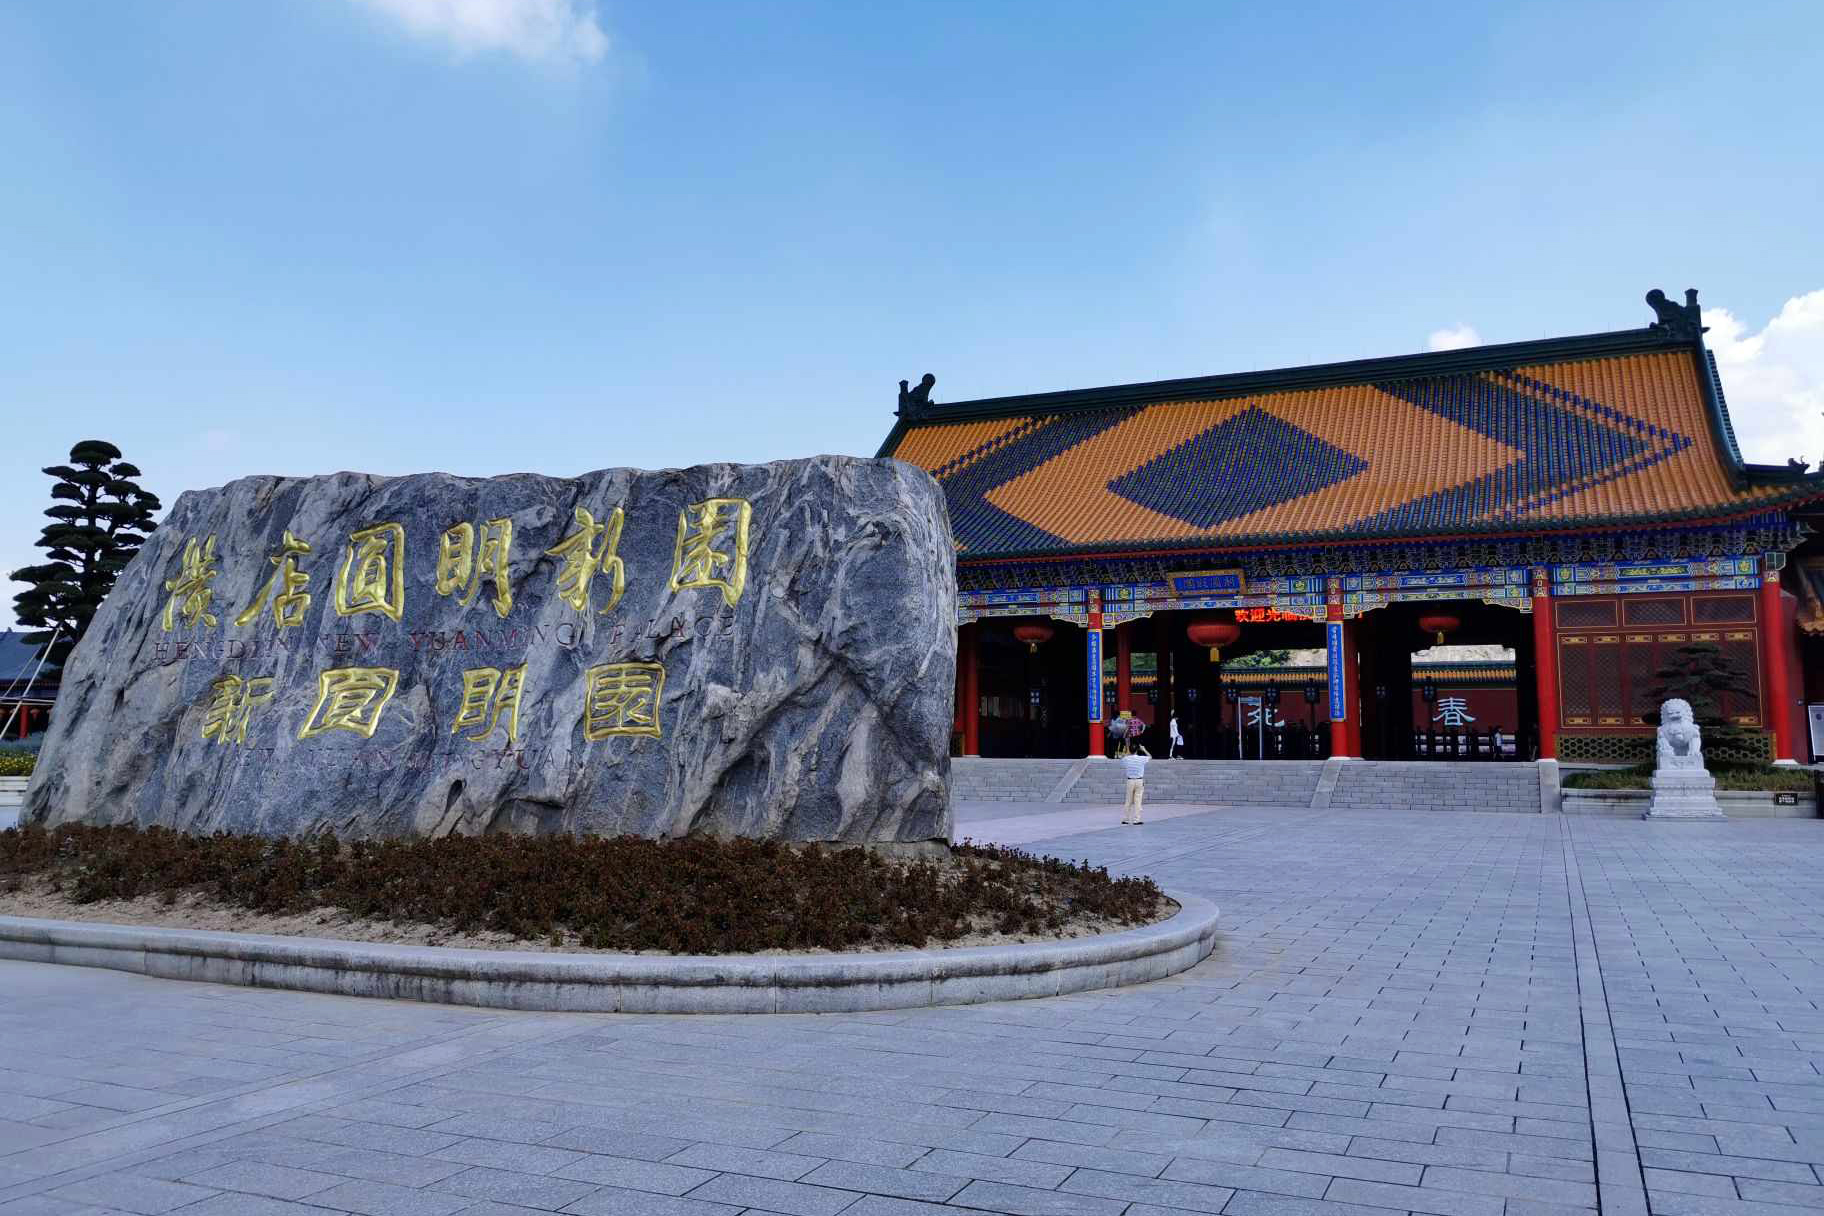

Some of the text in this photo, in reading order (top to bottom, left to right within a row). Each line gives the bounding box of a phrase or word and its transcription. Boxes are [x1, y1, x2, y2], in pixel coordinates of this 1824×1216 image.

[1235, 607, 1313, 623] 欢迎光临
[609, 615, 736, 645] PALACE
[1433, 697, 1476, 726] 春
